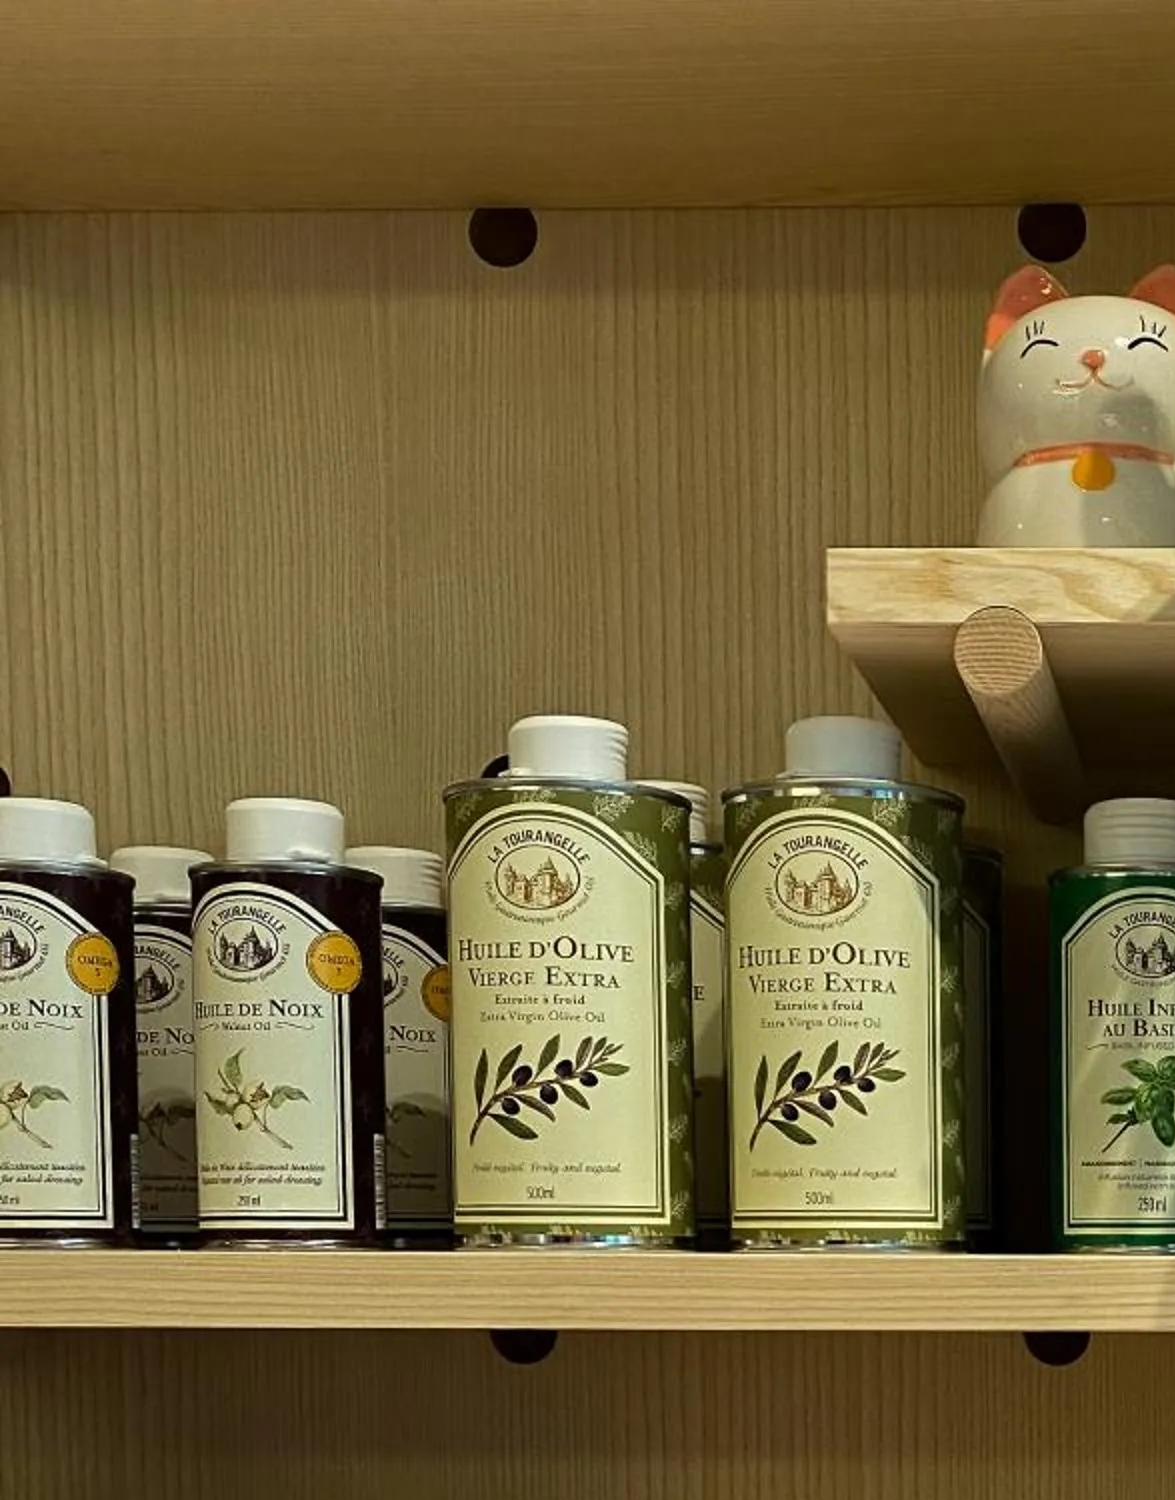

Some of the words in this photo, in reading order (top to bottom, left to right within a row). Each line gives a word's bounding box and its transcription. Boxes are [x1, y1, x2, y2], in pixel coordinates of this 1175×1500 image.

[486, 844, 503, 864] LA
[502, 829, 591, 865] TOURANGELLE
[767, 851, 784, 871] LA
[782, 835, 870, 871] TOURANGELLE
[217, 905, 287, 935] TOURANGELLE
[1108, 924, 1124, 940] LA
[458, 939, 522, 962] HUILE
[528, 935, 635, 963] D'OLIVE
[738, 946, 801, 969] HUILE
[808, 941, 911, 968] D'OLIVE
[468, 967, 535, 987] VIERGE
[544, 966, 621, 989] EXTRA
[749, 973, 815, 993] VIERGE
[824, 971, 897, 994] EXTRA
[28, 999, 83, 1019] NOIX
[195, 1002, 233, 1019] HUILE
[238, 1003, 263, 1017] DE
[269, 1000, 324, 1018] NOIX
[1087, 999, 1143, 1017] HUILE
[164, 1026, 195, 1045] NO
[390, 1025, 437, 1043] NOIX
[1103, 1022, 1125, 1037] AU
